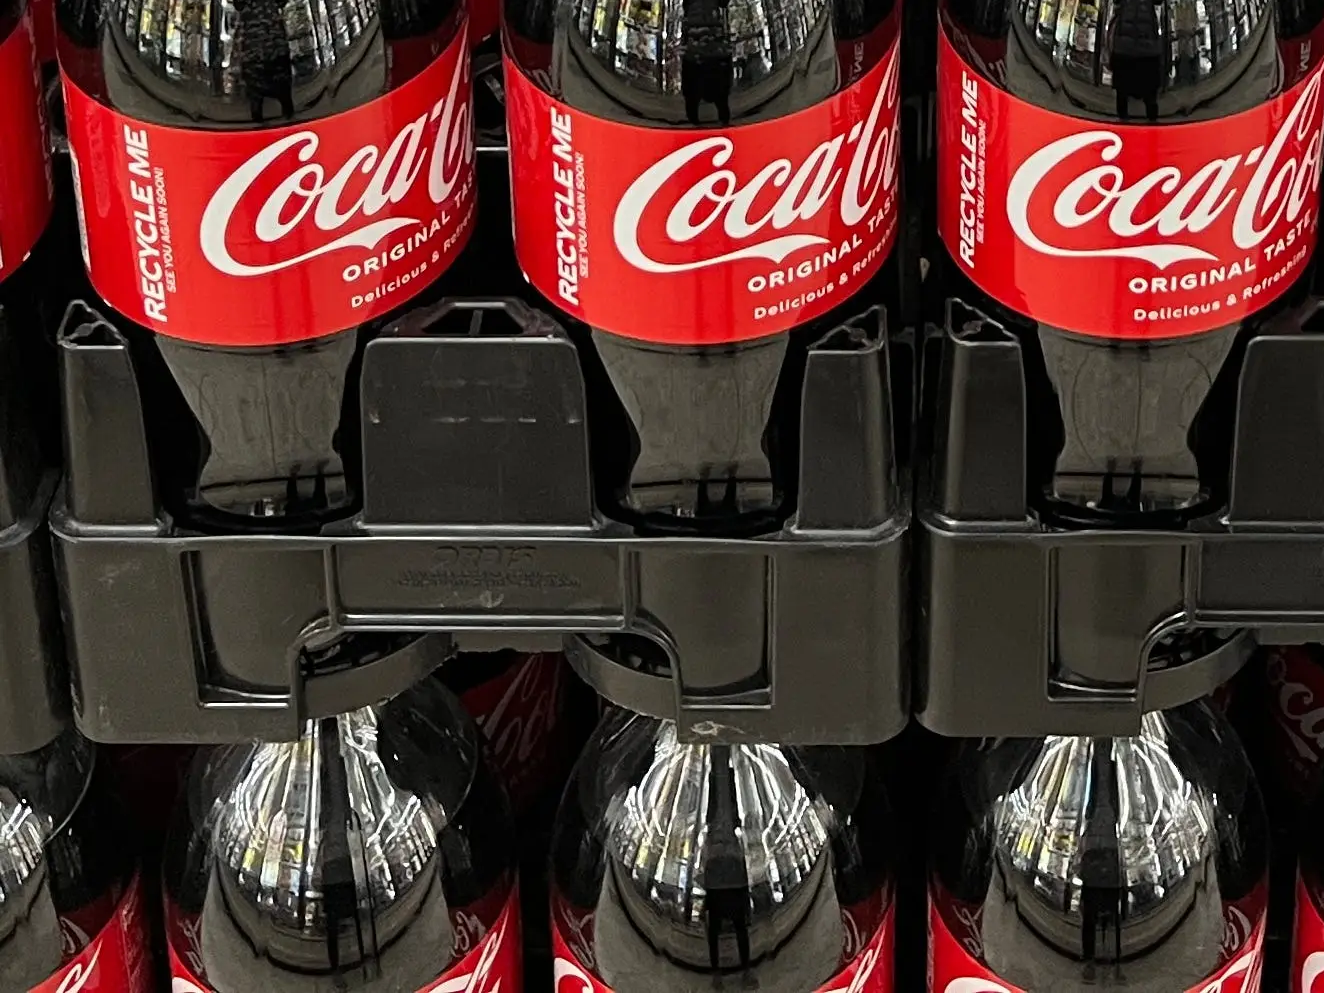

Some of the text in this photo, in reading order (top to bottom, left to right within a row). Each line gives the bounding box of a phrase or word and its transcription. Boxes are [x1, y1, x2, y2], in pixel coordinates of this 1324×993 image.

[959, 71, 978, 269] RECYCLE ME
[124, 124, 167, 323] RECYCLE ME
[342, 175, 473, 283] ORIGINAL TAS
[551, 106, 579, 306] RECYCLE ME
[160, 243, 173, 268] YOU
[166, 269, 176, 293] SEE
[351, 264, 428, 309] Delicious
[431, 250, 440, 263] &
[747, 233, 862, 293] ORIGINAL
[1128, 208, 1312, 294] ORIGINAL TASTE
[754, 283, 834, 320] Delicious
[838, 272, 848, 285] &
[1133, 300, 1220, 321] Delicious
[1226, 294, 1237, 306] &
